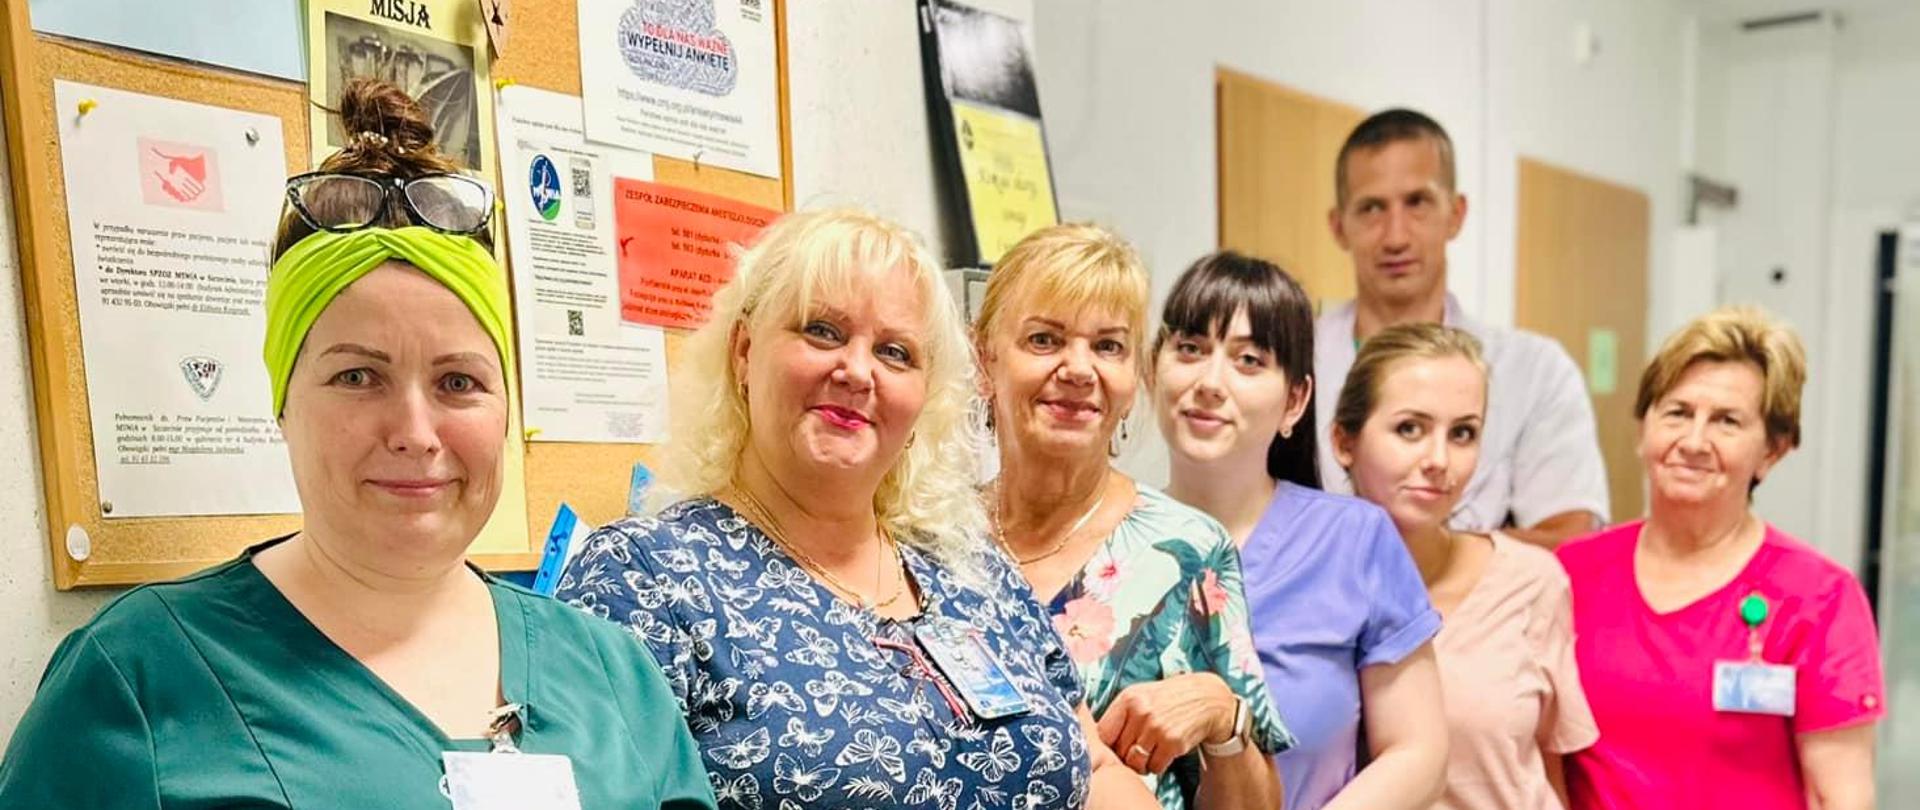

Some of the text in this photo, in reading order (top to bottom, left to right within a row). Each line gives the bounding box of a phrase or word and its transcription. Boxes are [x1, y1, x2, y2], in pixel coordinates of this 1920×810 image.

[369, 0, 432, 29] MISJA
[626, 30, 684, 59] WYPEŁNIJ
[685, 49, 729, 71] ANKIETĘ
